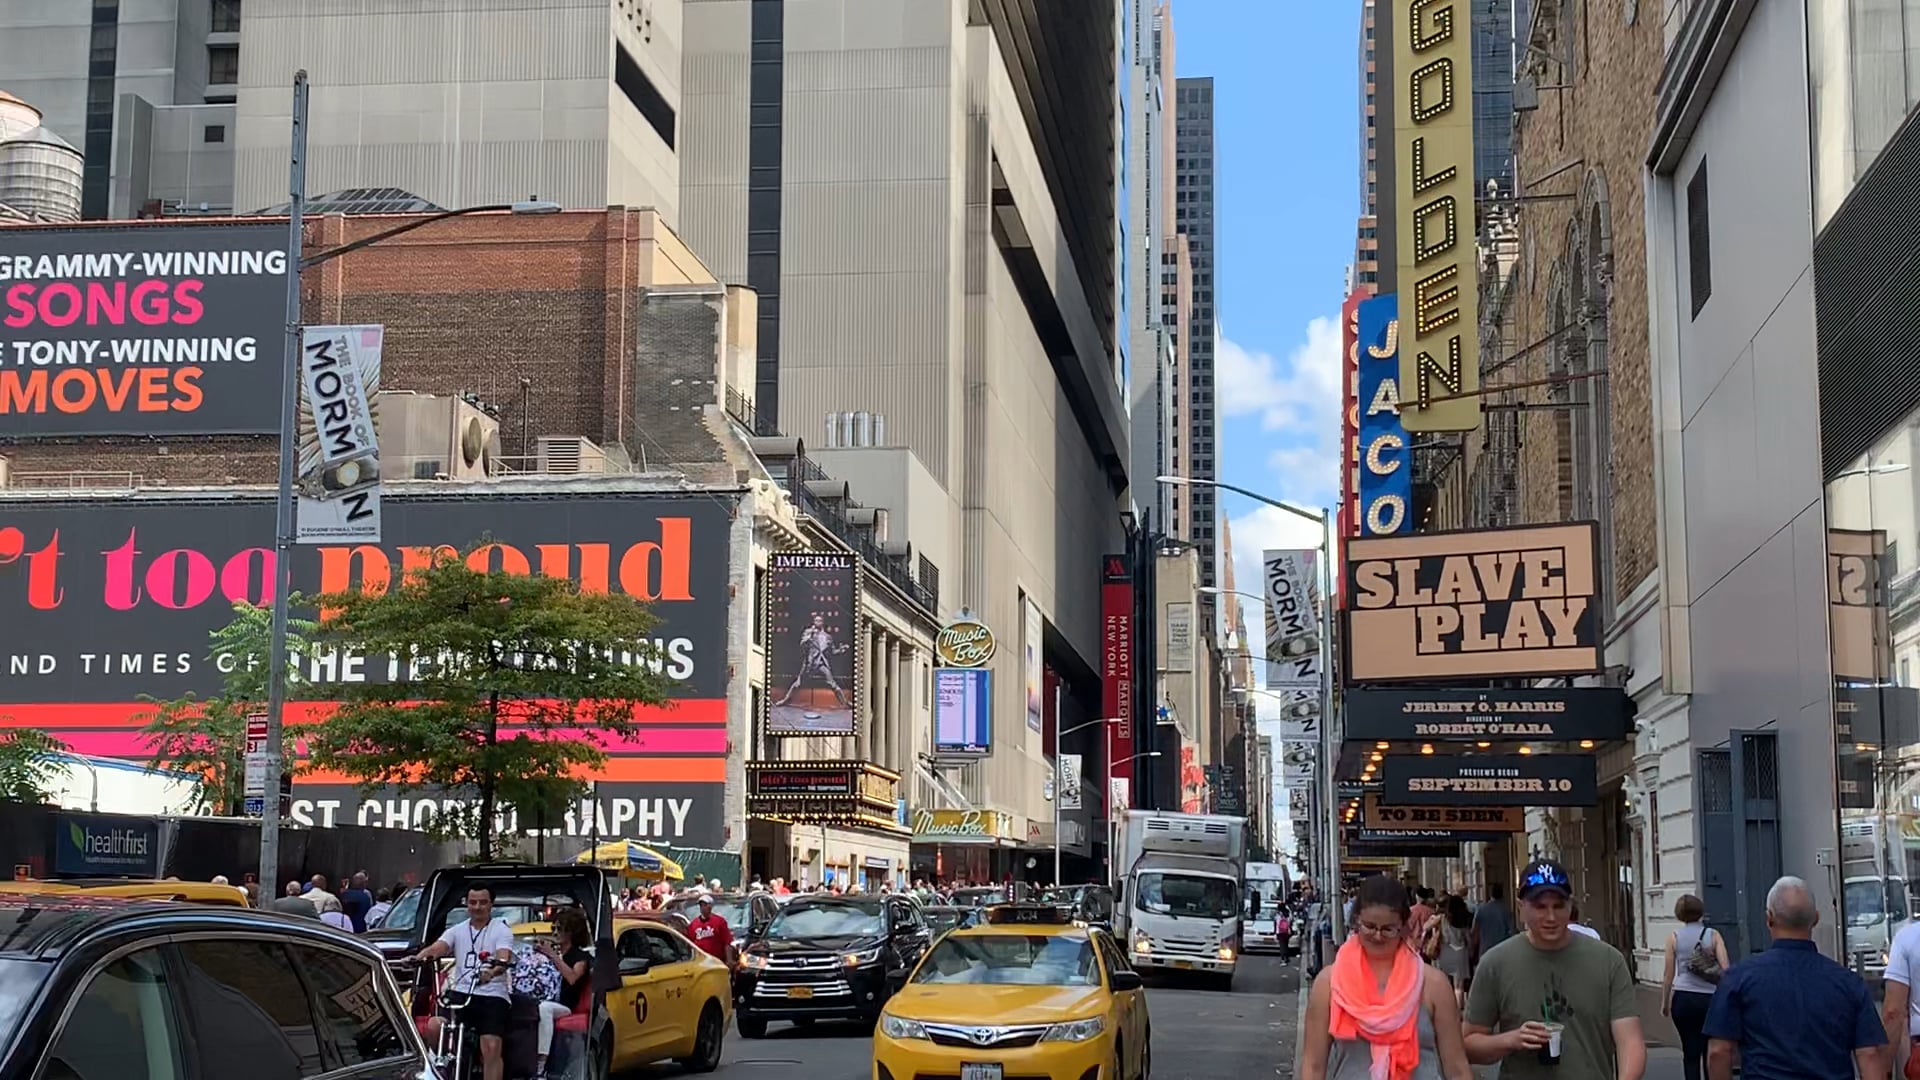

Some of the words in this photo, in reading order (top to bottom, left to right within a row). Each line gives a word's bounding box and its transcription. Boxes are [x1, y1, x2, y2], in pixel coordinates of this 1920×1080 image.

[1410, 0, 1462, 411] GOLDEN
[0, 251, 286, 279] GRAMMY-WINNING
[4, 280, 204, 327] SONGS
[12, 337, 256, 366] TONY-WINNING
[0, 367, 204, 414] MOVES
[100, 525, 291, 611] too
[776, 556, 850, 568] IMPERIAL
[1355, 550, 1564, 608] SLAVE
[943, 627, 986, 647] Music
[1107, 615, 1116, 642] NEW
[1417, 597, 1587, 654] PLAY
[952, 643, 992, 662] Box
[1107, 644, 1116, 677] YORK
[1119, 615, 1129, 679] MARRIOTT
[80, 653, 192, 675] TIMES
[1402, 702, 1476, 713] JEREMY
[1478, 702, 1492, 713] O.
[1495, 702, 1566, 713] HARRIS
[1415, 724, 1486, 734] ROBERT
[1488, 723, 1554, 734] O'HARA
[1408, 778, 1544, 792] SEPTEMBER
[1548, 778, 1572, 791] 10
[1459, 768, 1495, 777] PREVIEWS
[1497, 768, 1520, 777] BEGIN
[915, 809, 958, 835] Music
[957, 809, 986, 835] Box
[1378, 808, 1407, 822] TO
[1411, 808, 1442, 822] BE
[1445, 807, 1509, 822] SEEN.
[85, 826, 147, 855] healthfirst
